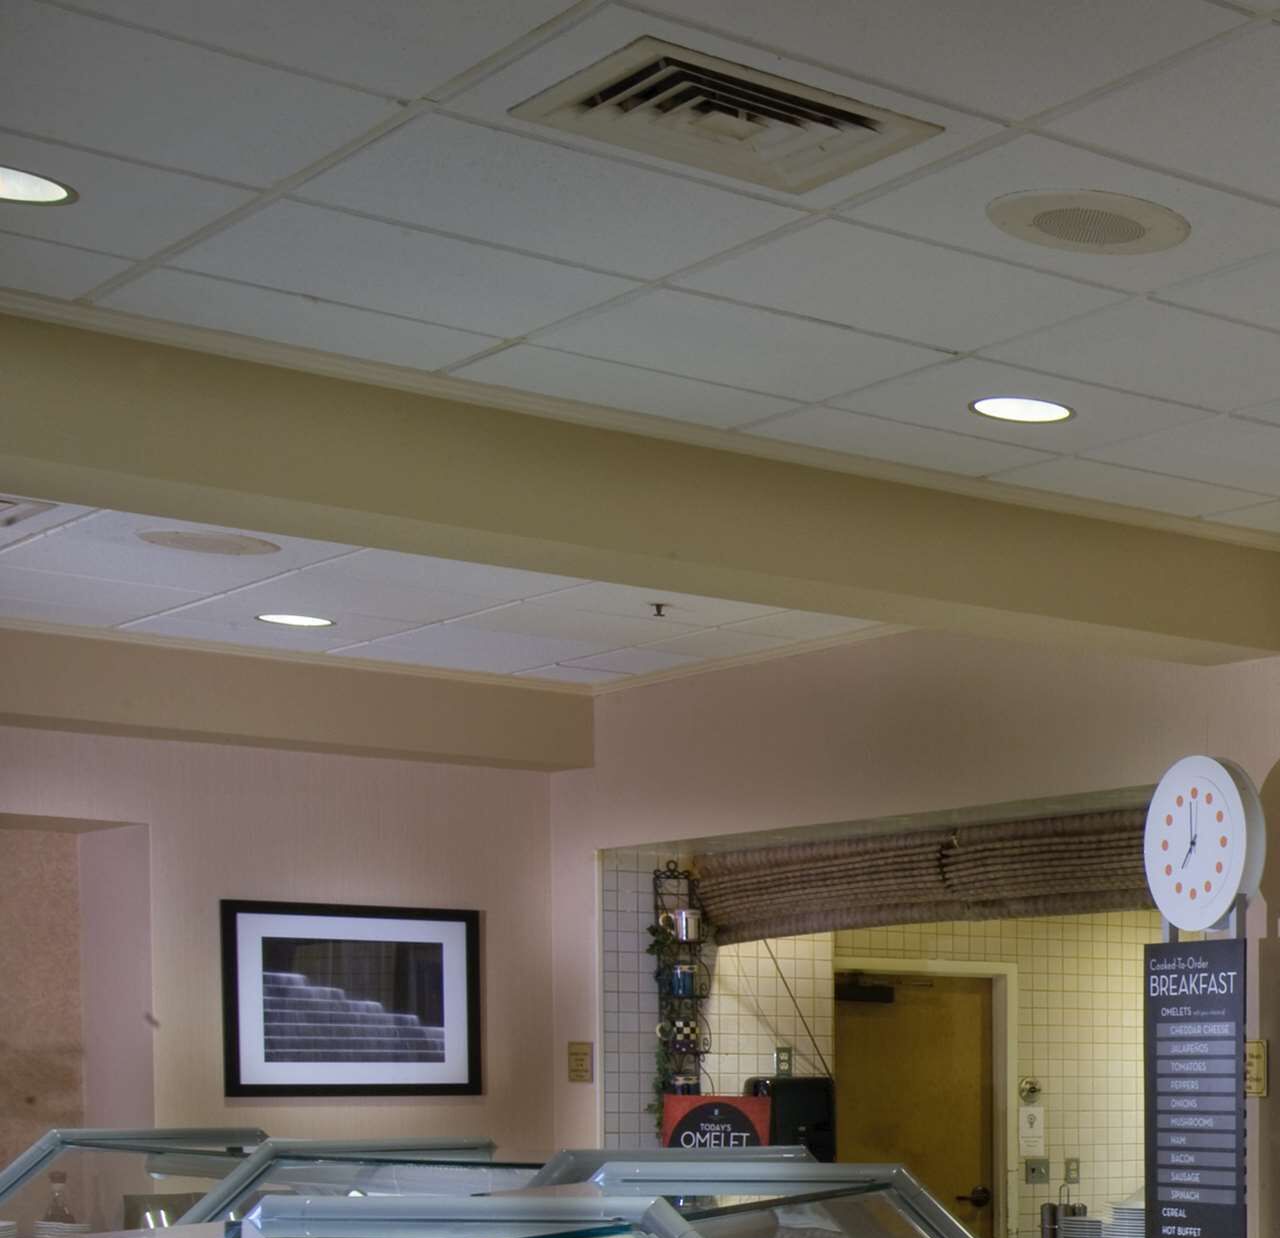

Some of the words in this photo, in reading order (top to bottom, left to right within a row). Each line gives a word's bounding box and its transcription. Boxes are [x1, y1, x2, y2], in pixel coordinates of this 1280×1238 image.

[1149, 971, 1237, 997] BREAKFAST
[1161, 1006, 1192, 1017] OMELETS
[1202, 1023, 1230, 1034] CHEESE
[700, 1122, 732, 1132] TODAY'S
[680, 1131, 751, 1149] OMELET
[1161, 1207, 1187, 1218] CEREAL
[1161, 1225, 1176, 1236] HOT
[1177, 1226, 1202, 1237] BUFFET
